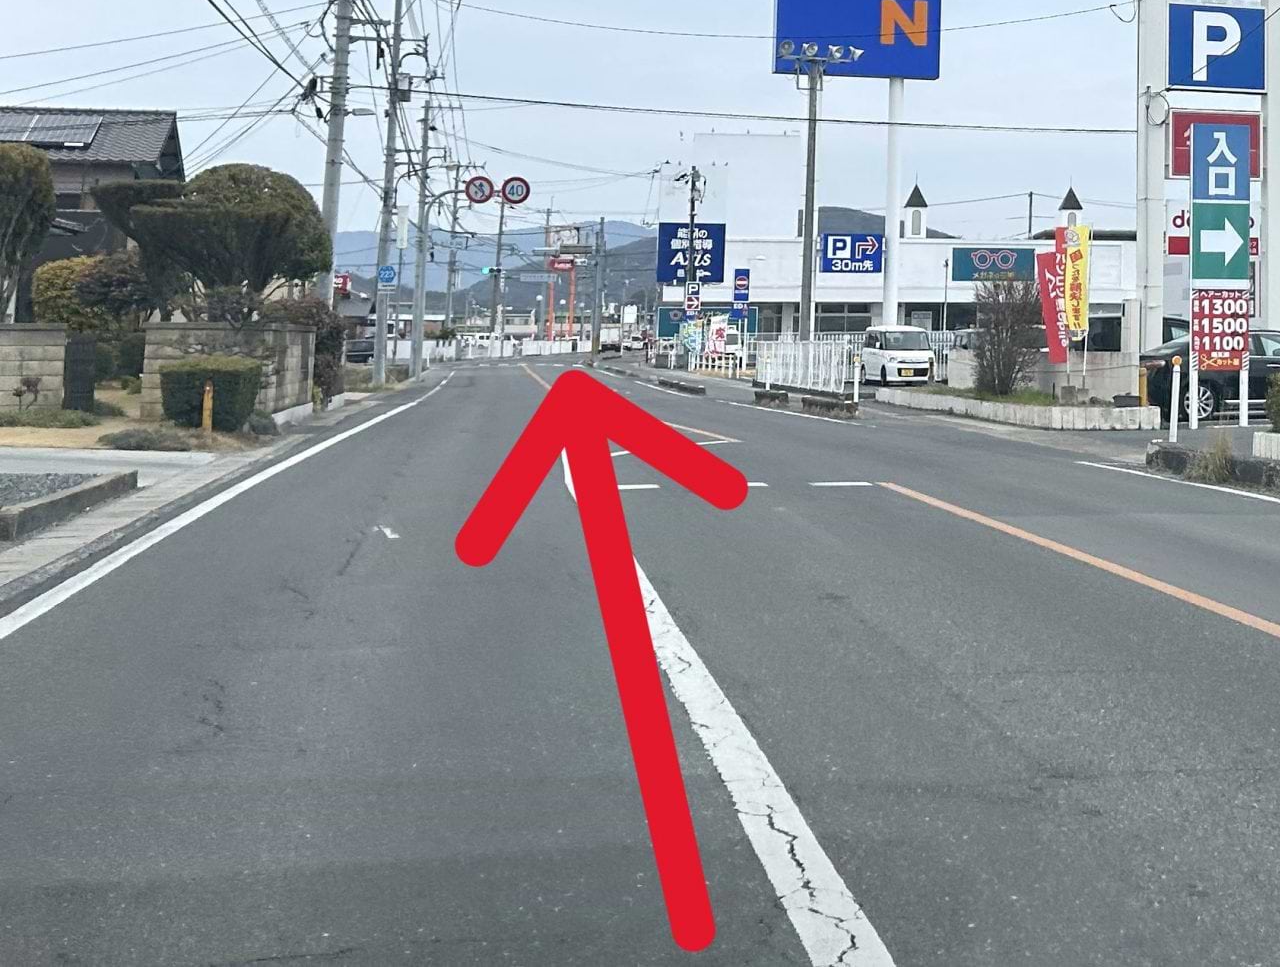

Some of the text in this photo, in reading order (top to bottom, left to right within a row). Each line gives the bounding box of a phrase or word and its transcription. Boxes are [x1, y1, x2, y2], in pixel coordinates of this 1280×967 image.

[1192, 10, 1242, 81] P
[1207, 132, 1237, 196] 入口
[508, 185, 523, 196] 40
[832, 238, 847, 256] P
[831, 259, 873, 271] 30m先
[688, 284, 698, 294] P
[1200, 290, 1241, 298] ヘアーカット
[1201, 299, 1247, 314] 1300
[1201, 318, 1247, 334] 1500
[1202, 336, 1244, 350] 1100
